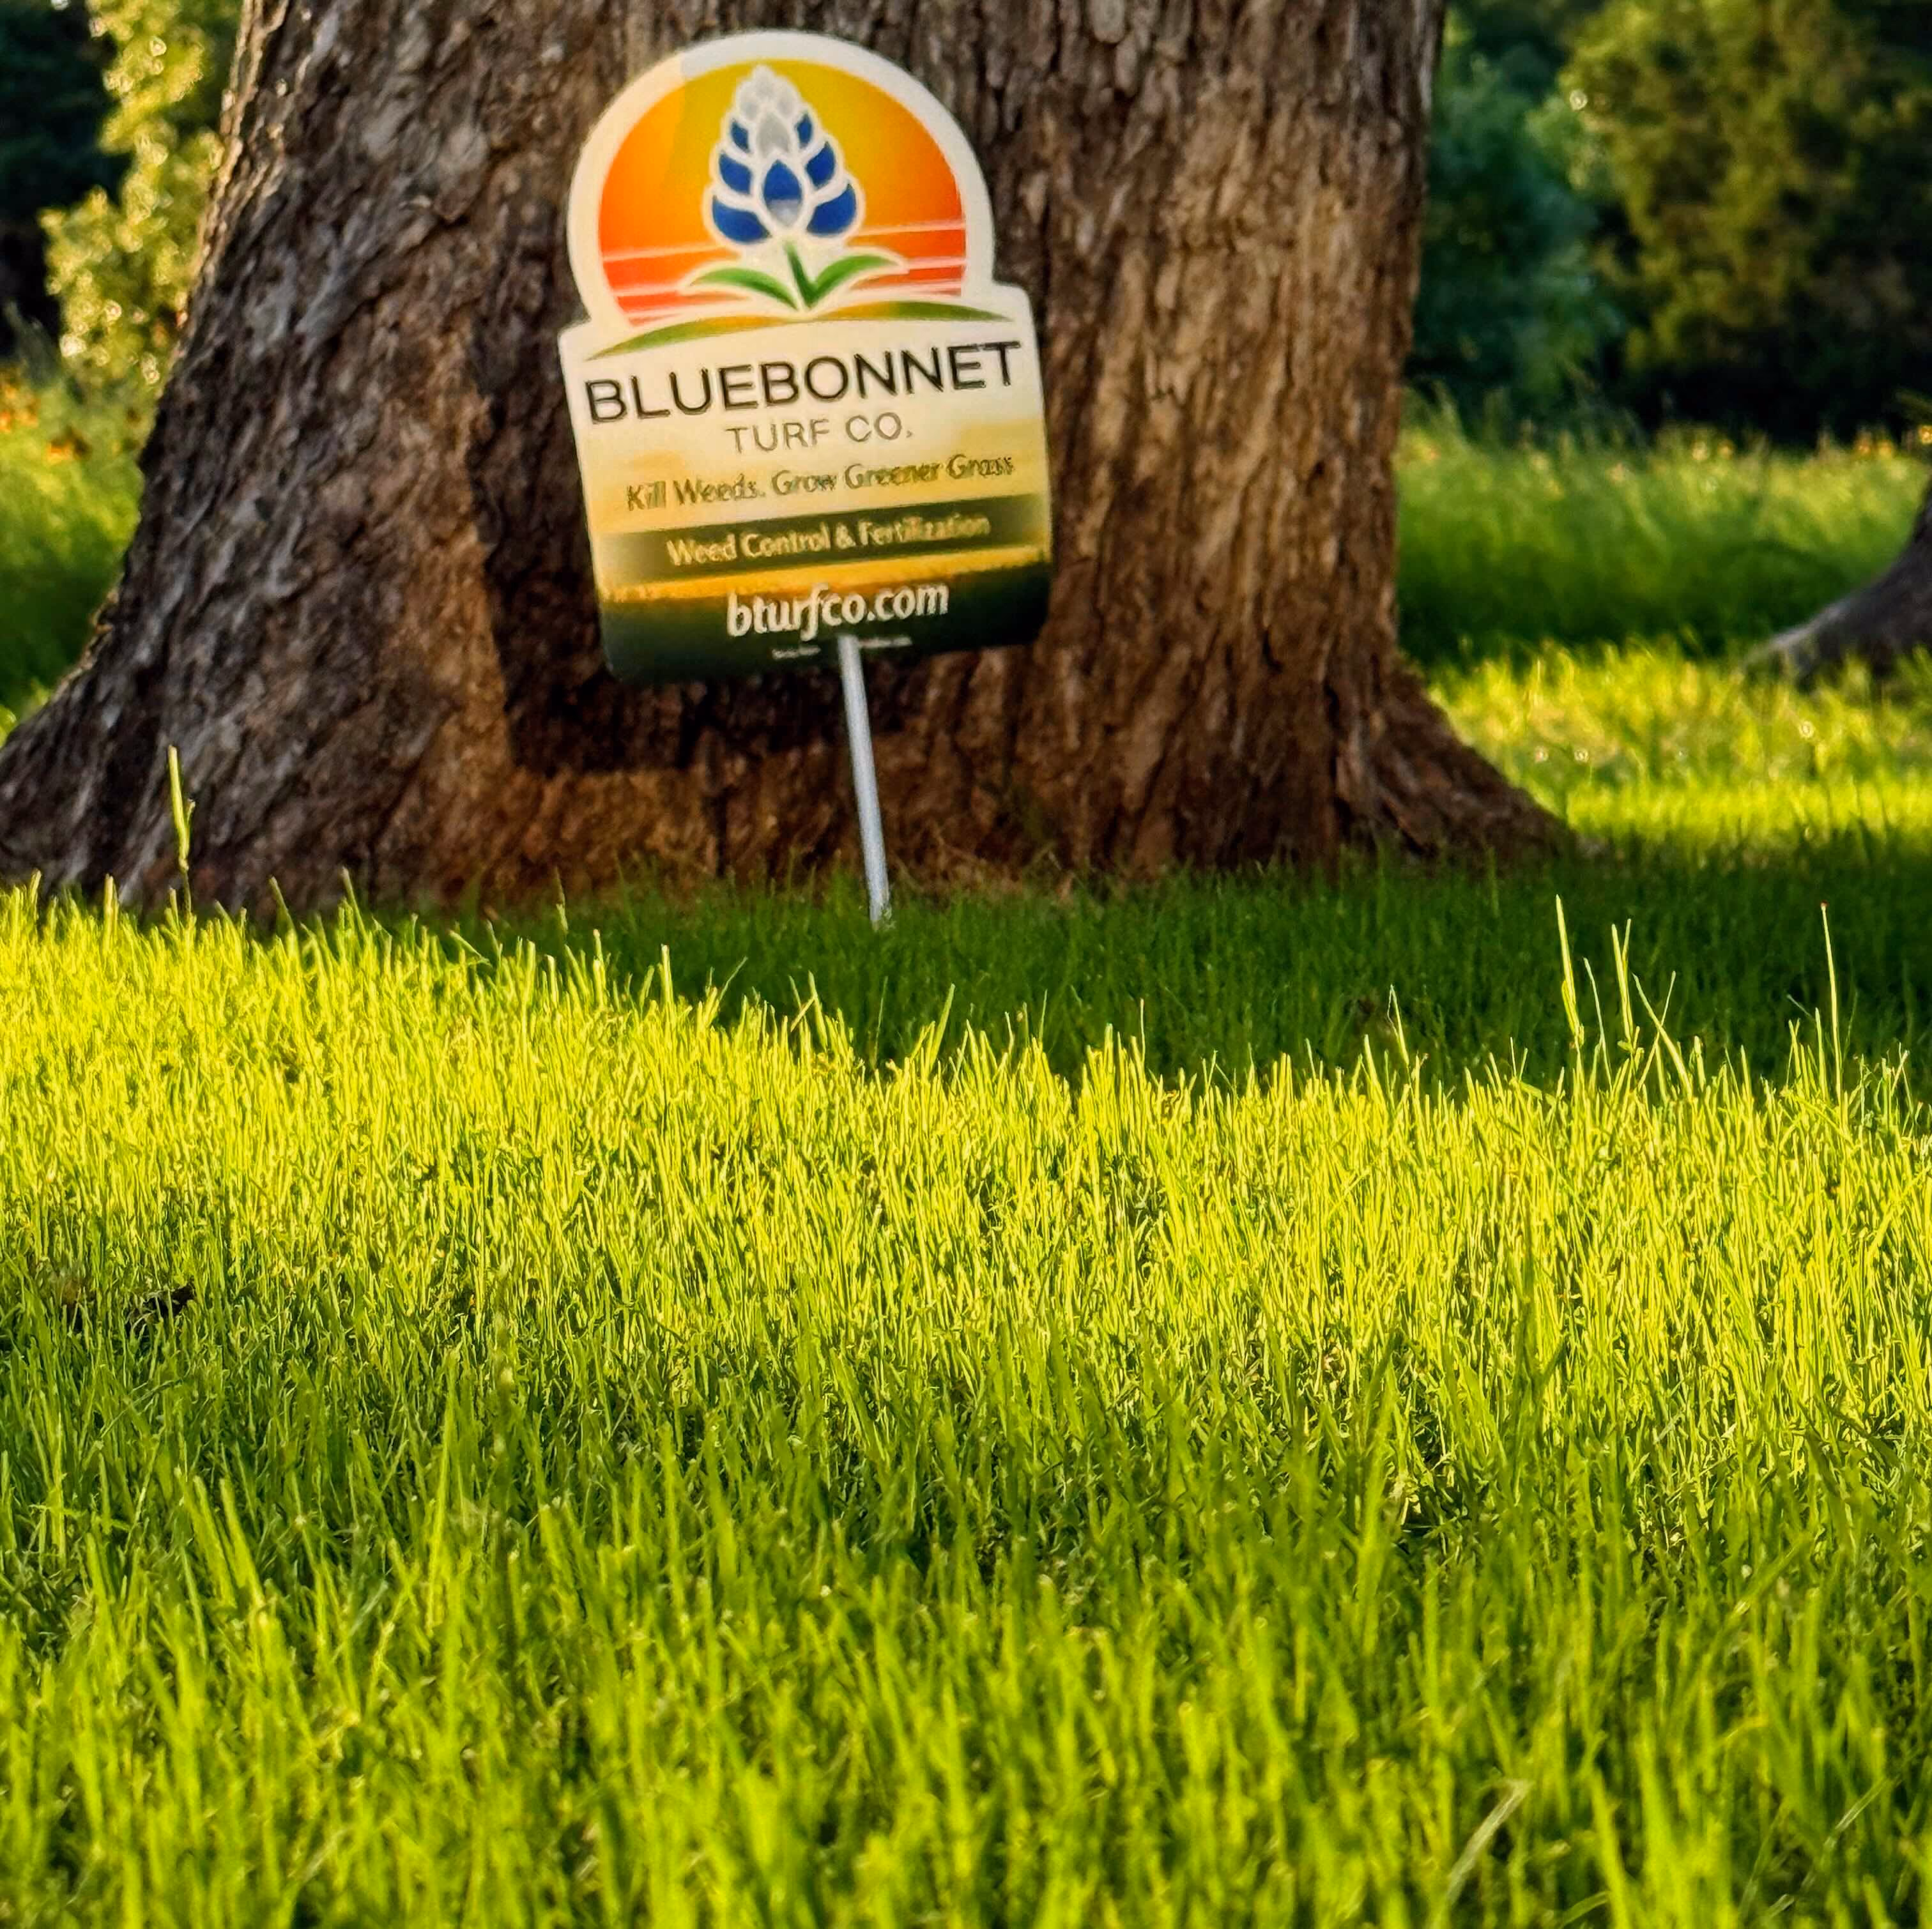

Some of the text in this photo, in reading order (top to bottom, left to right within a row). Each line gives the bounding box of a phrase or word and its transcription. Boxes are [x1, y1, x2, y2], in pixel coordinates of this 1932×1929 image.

[585, 340, 1021, 424] BLUEBONNET
[726, 412, 914, 454] TURF CO.
[626, 453, 1015, 511] Kill Weeds. Grow Greener Grass
[666, 512, 992, 567] Weed Control & Fertilization
[726, 583, 950, 642] bturfco.com
